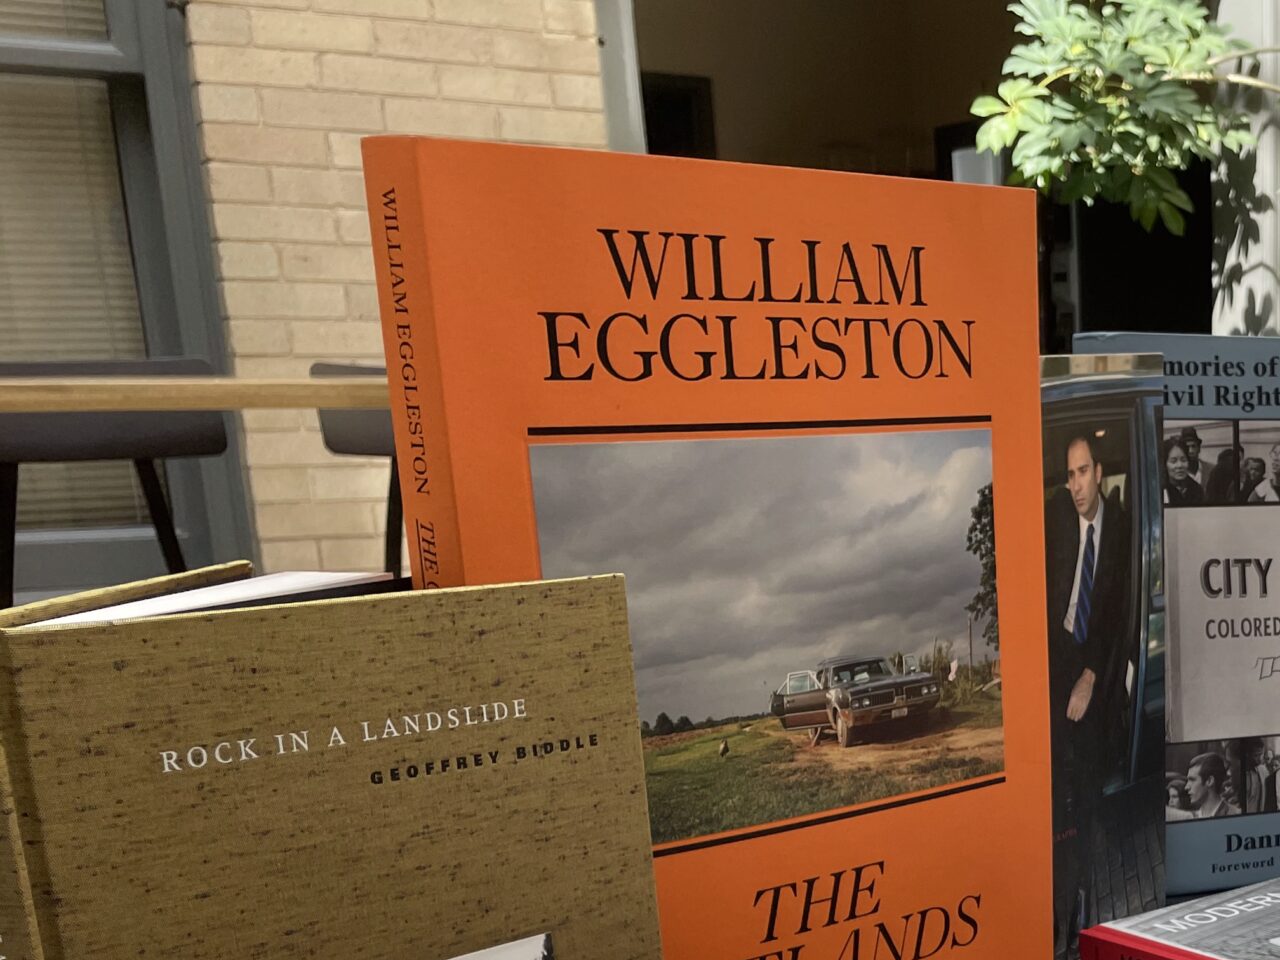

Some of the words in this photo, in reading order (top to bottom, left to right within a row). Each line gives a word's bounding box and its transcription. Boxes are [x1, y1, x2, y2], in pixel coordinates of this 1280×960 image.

[597, 228, 927, 306] WILLIAM
[537, 311, 976, 382] EGGLESTON
[1163, 355, 1245, 378] mories
[1254, 356, 1279, 378] of
[380, 187, 410, 314] WILLIAM
[396, 323, 430, 495] EGGLESTON
[419, 522, 439, 574] THE
[1163, 384, 1203, 406] ivil
[1201, 558, 1273, 599] CITY
[160, 738, 257, 773] ROCK
[275, 729, 310, 754] IN
[328, 726, 347, 746] A
[362, 698, 528, 742] LANDSLIDE
[370, 750, 499, 785] GEOFFREY
[515, 733, 600, 760] BIDDLE
[1211, 860, 1274, 873] Foreword
[753, 860, 885, 944] THE
